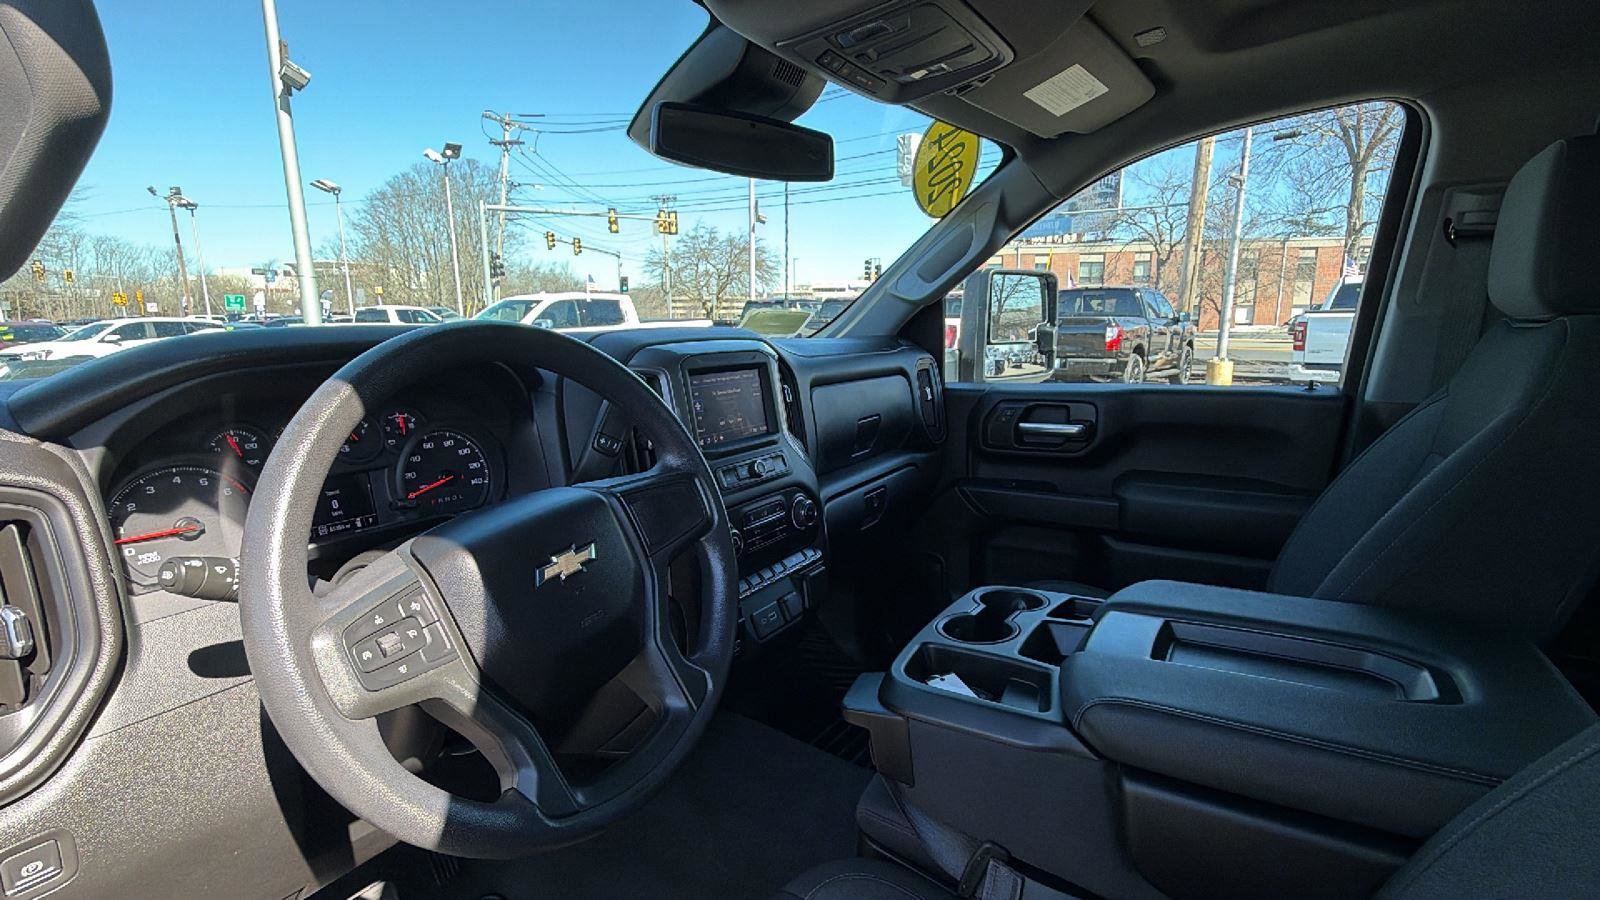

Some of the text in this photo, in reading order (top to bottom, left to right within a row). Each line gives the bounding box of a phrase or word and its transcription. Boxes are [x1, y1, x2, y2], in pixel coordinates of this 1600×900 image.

[443, 439, 454, 447] 80
[457, 448, 471, 456] 100
[468, 461, 481, 470] 120
[172, 476, 182, 484] 4
[199, 478, 209, 486] 5
[470, 477, 483, 486] 140
[146, 486, 156, 494] 3
[224, 487, 233, 496] 6
[126, 503, 136, 511] 2
[124, 548, 136, 556] 0
